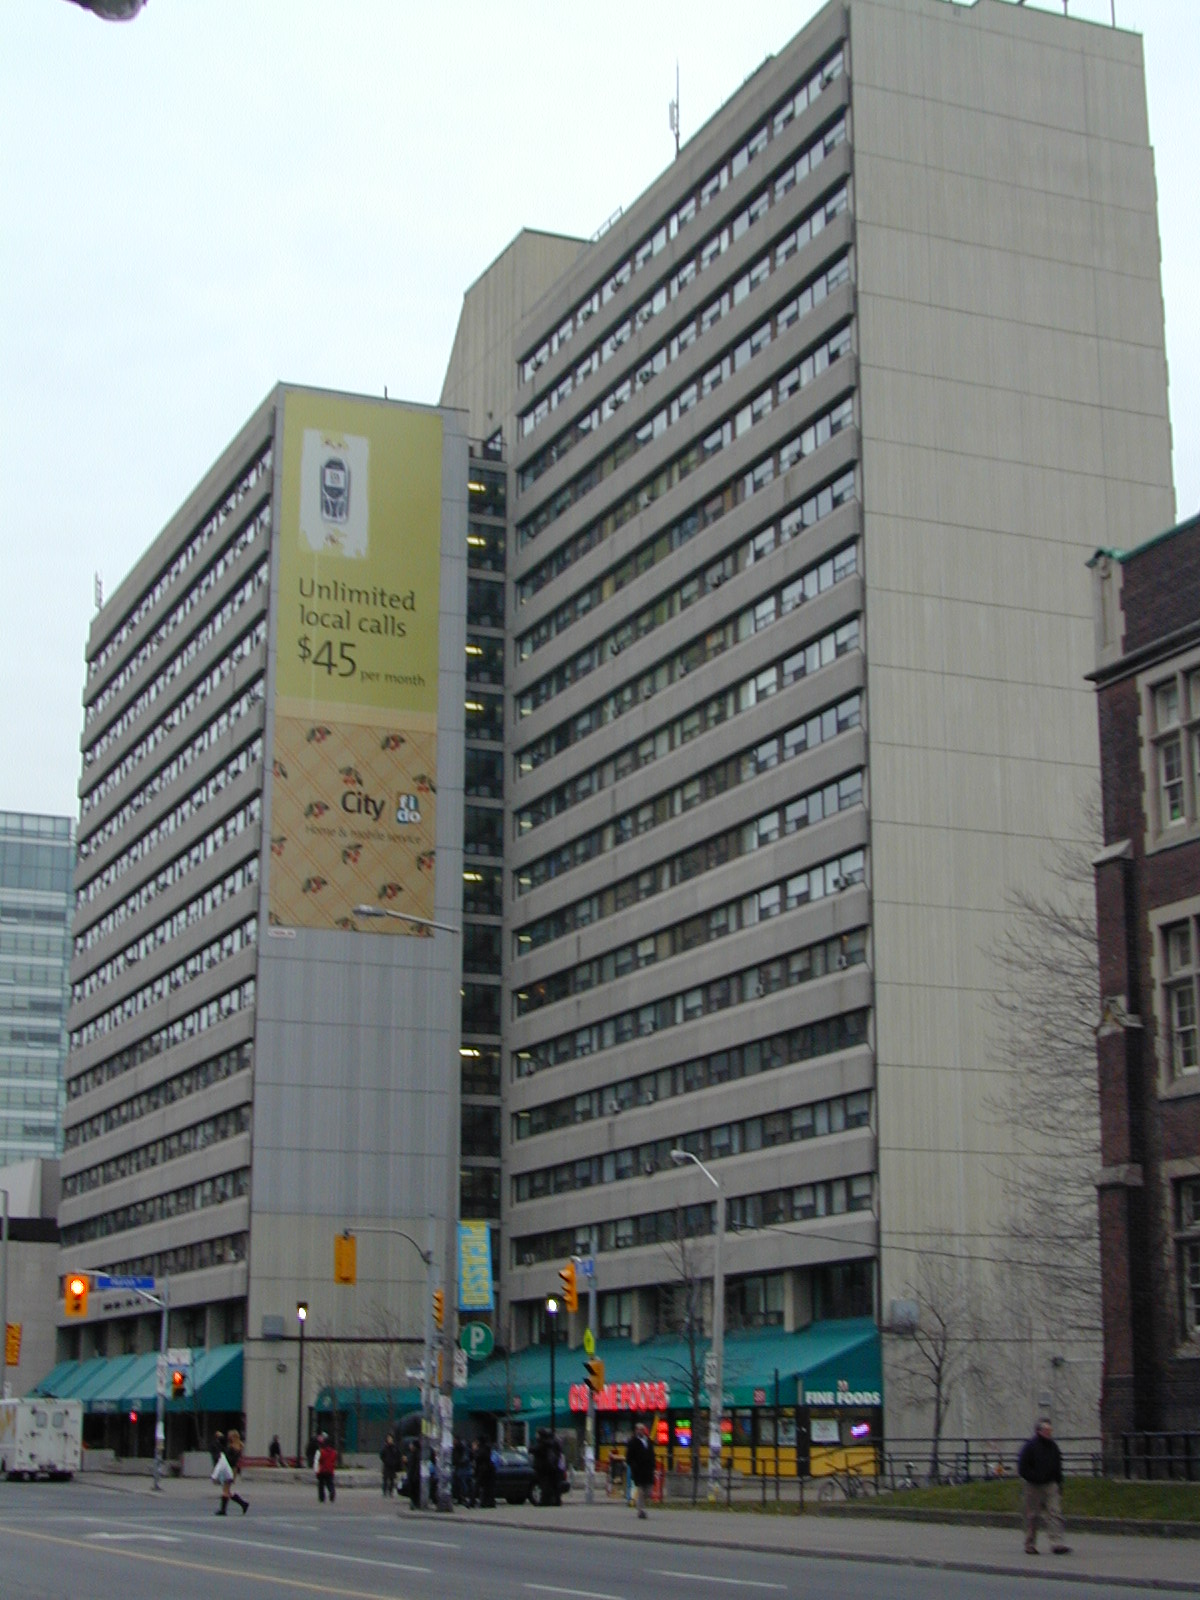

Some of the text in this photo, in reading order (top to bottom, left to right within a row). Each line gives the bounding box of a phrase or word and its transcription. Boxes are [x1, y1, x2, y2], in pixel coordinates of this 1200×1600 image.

[299, 577, 416, 612] Unlimited
[299, 603, 407, 637] local calls
[297, 633, 426, 686] $45 per month
[341, 790, 386, 822] City
[461, 1220, 489, 1305] PICASSO
[470, 1326, 485, 1349] P
[620, 1381, 670, 1413] FOODS
[804, 1390, 881, 1406] FINE FOODS
